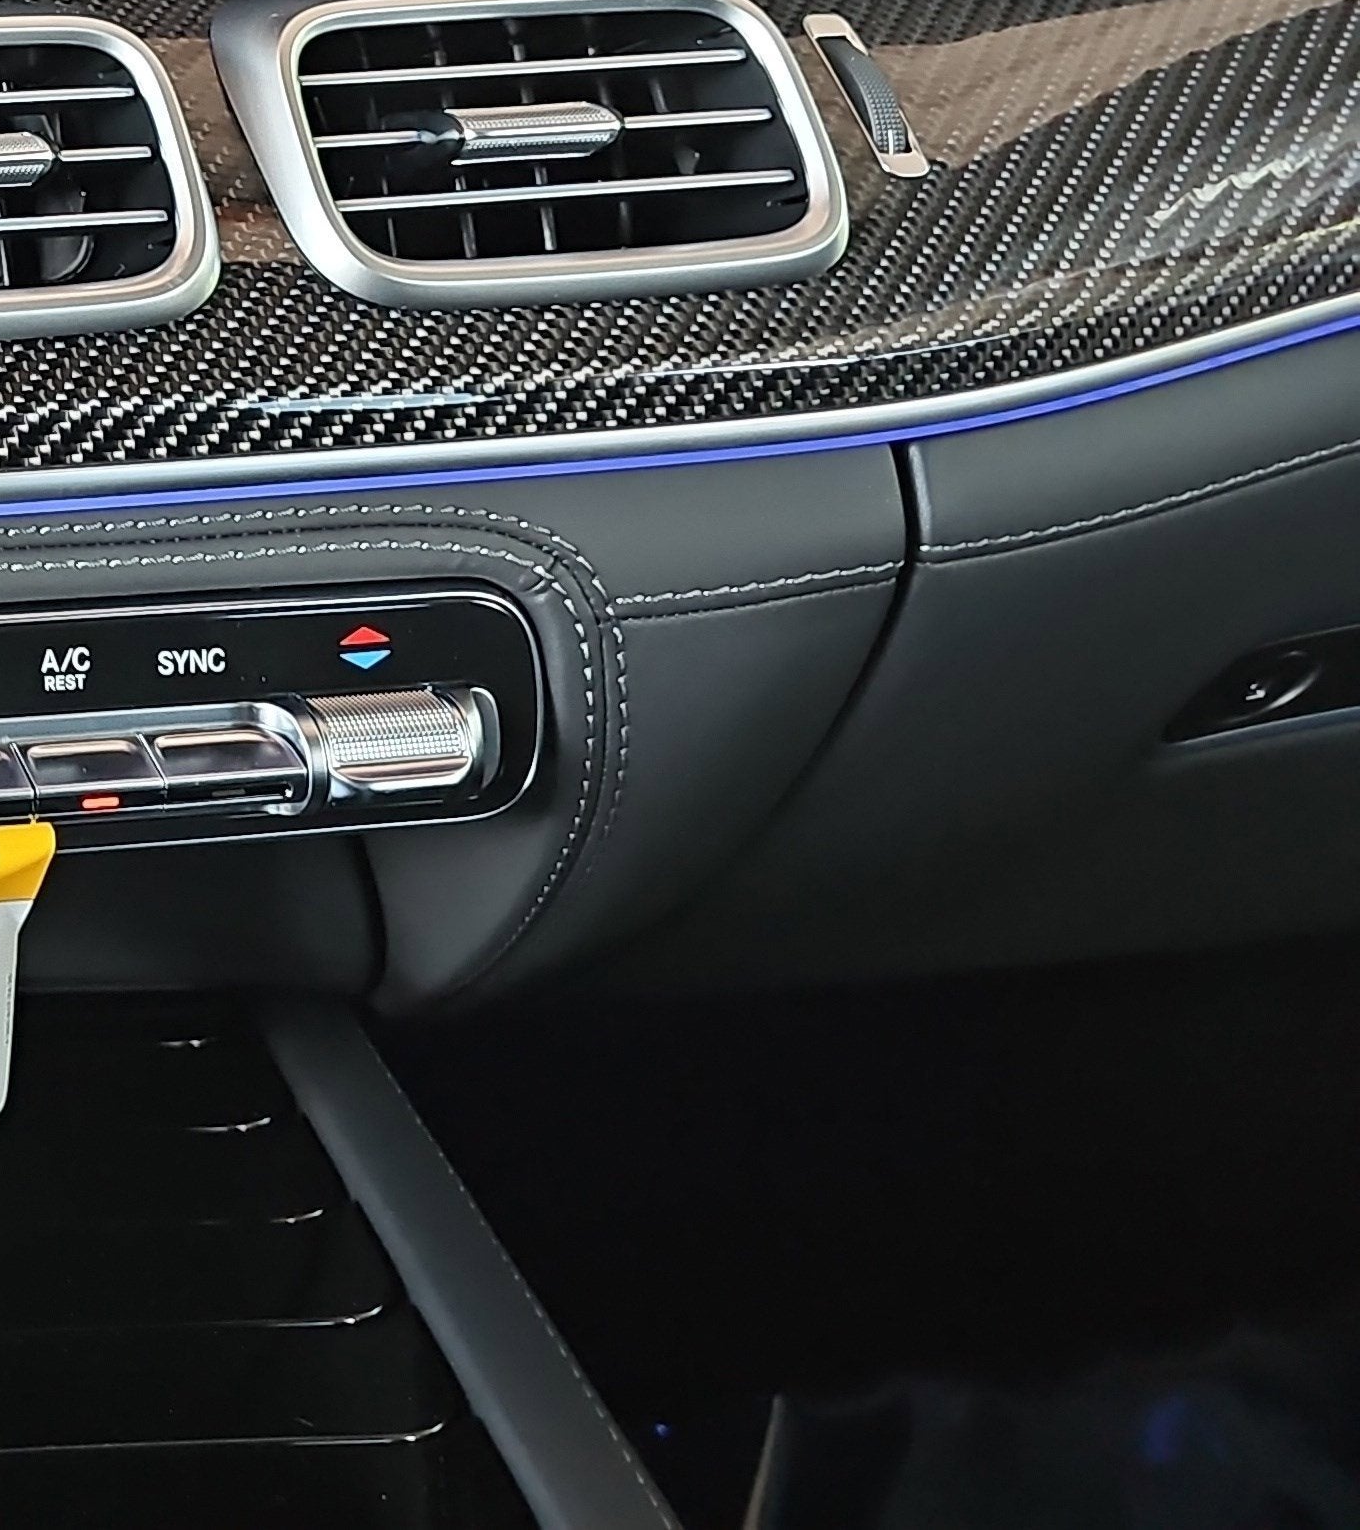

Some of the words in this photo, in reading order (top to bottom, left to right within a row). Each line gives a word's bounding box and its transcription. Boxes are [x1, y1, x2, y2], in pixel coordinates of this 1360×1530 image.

[41, 647, 91, 674] A/C
[156, 648, 227, 676] SYNC
[44, 673, 86, 692] REST
